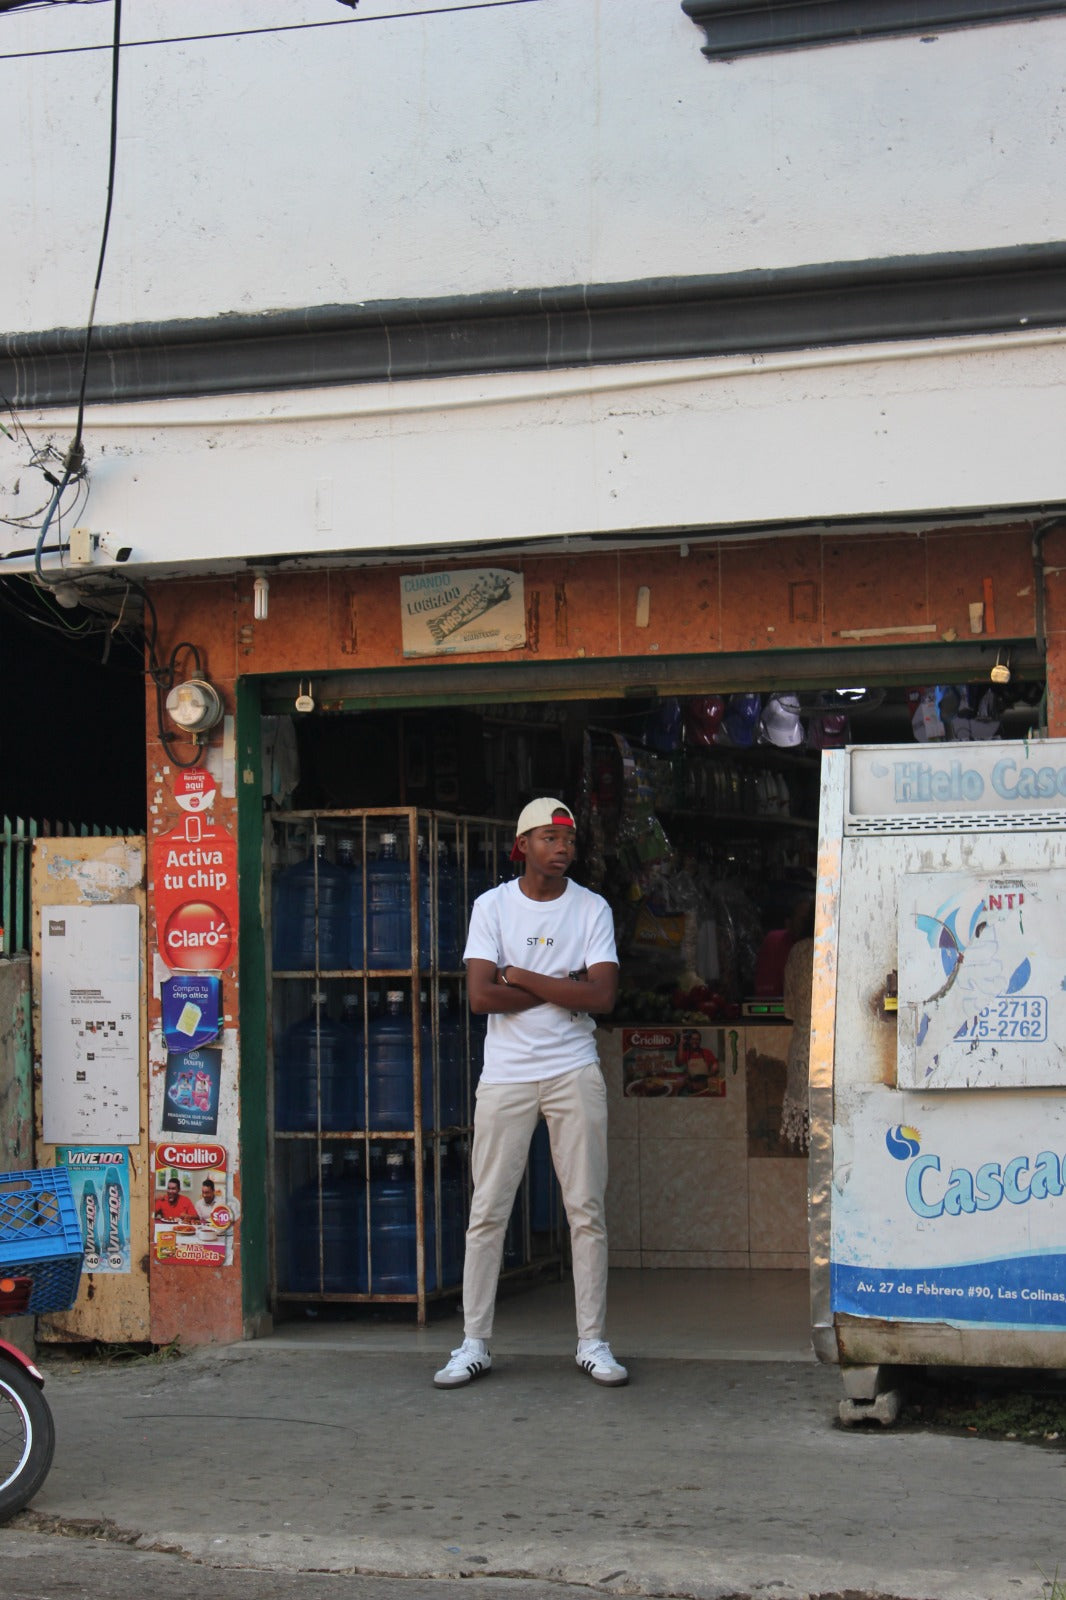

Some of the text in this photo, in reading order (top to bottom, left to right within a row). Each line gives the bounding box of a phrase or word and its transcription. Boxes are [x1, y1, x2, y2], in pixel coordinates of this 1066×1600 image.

[404, 574, 450, 592] CUANDO
[166, 848, 223, 868] Activa
[164, 869, 227, 891] tu chip
[168, 929, 219, 948] Claro
[172, 984, 200, 993] Compra
[183, 1058, 204, 1069] Downy
[67, 1150, 122, 1164] VIVE100
[163, 1146, 218, 1164] Criollito
[905, 1150, 1066, 1219] Casca
[175, 1249, 219, 1260] Completa
[857, 1282, 876, 1293] Av.
[879, 1282, 895, 1294] 27
[897, 1282, 913, 1295] de
[916, 1283, 964, 1297] Febrero
[967, 1286, 994, 1300] #90,
[997, 1287, 1018, 1300] Las
